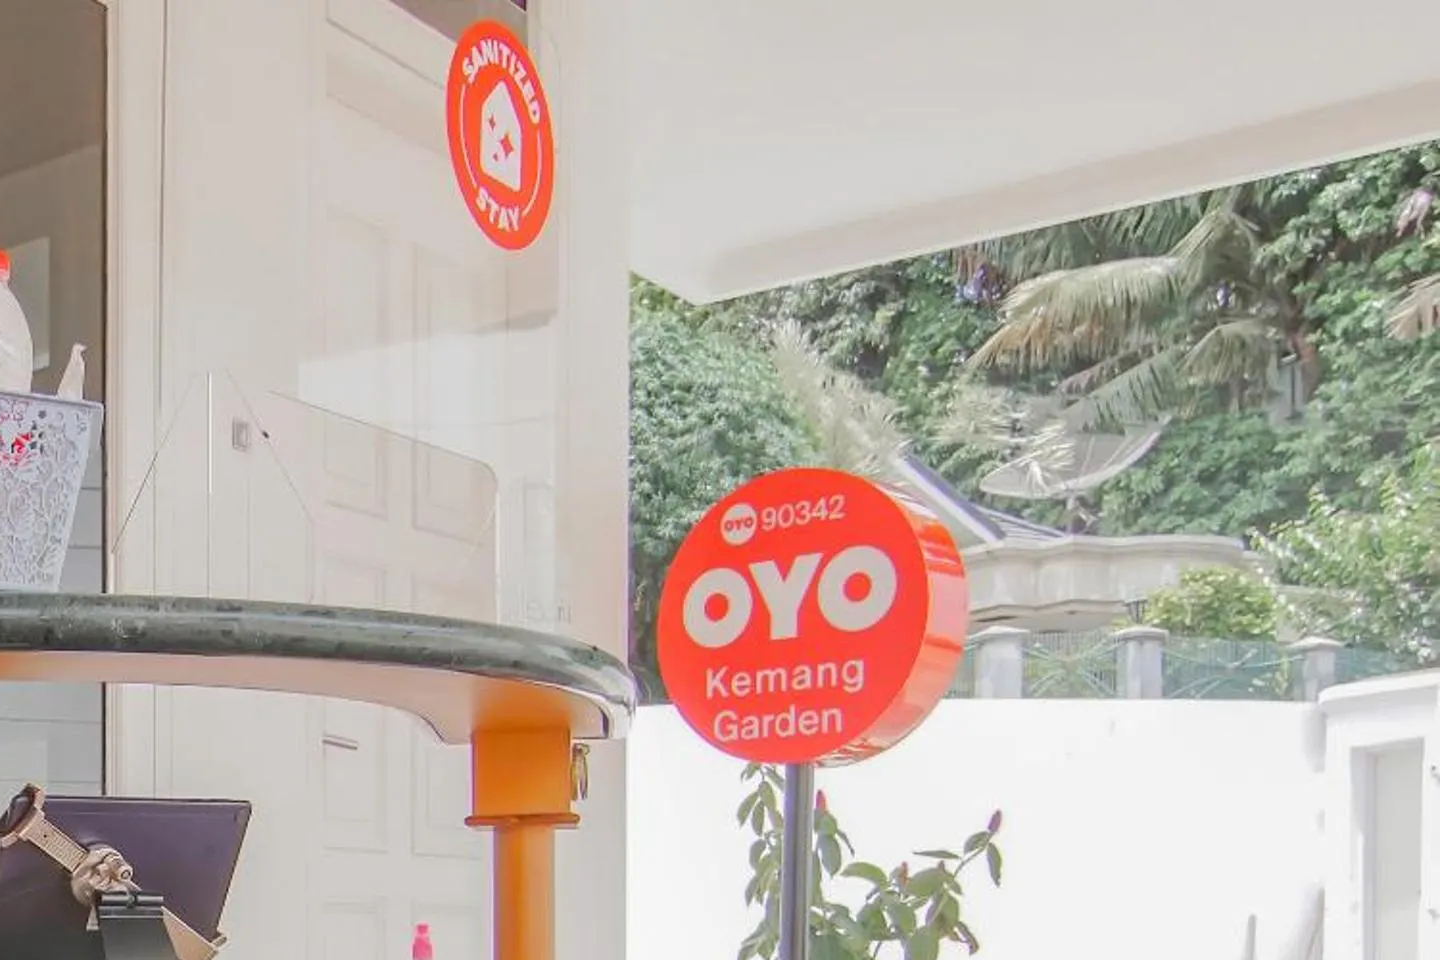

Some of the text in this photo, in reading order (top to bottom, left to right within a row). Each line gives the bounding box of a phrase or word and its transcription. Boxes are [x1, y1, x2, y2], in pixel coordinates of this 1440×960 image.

[462, 39, 541, 124] SANITIZED
[476, 186, 520, 232] STAY
[724, 494, 847, 533] OYO 90342
[682, 545, 898, 649] OYO
[705, 658, 865, 699] Kemang
[713, 704, 844, 742] Garden
